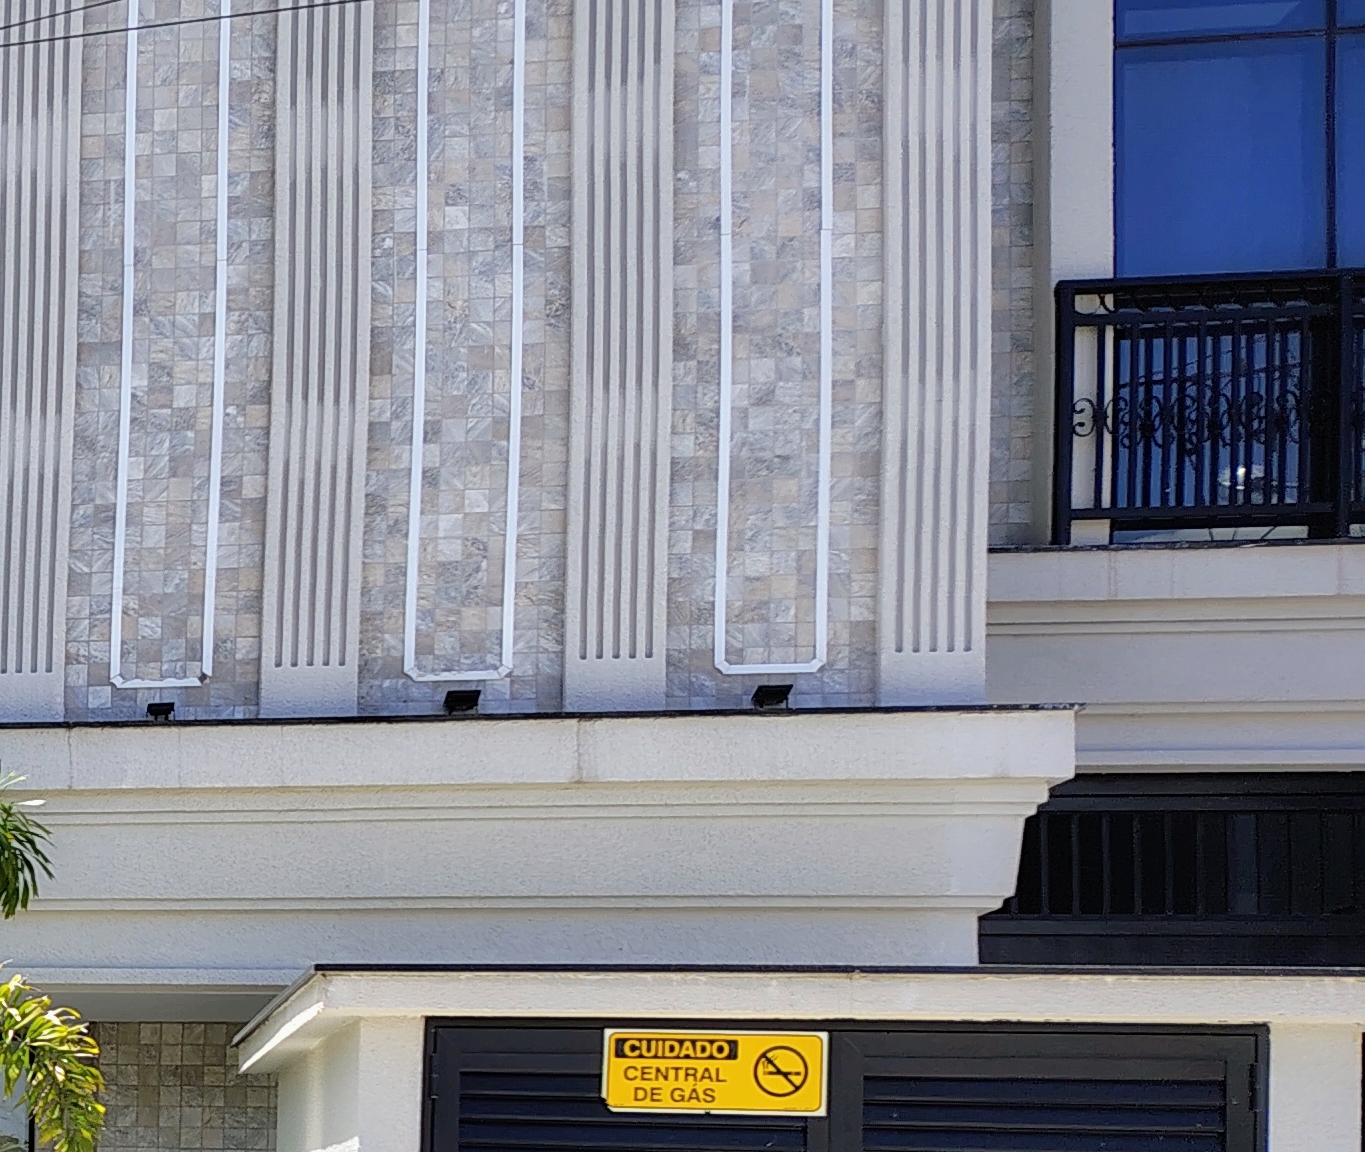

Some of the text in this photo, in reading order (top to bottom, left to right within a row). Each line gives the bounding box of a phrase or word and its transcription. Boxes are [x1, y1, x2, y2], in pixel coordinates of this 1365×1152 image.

[622, 1039, 731, 1059] CUIDADO
[623, 1066, 728, 1083] CENTRAL
[633, 1083, 717, 1104] DE GÁS
